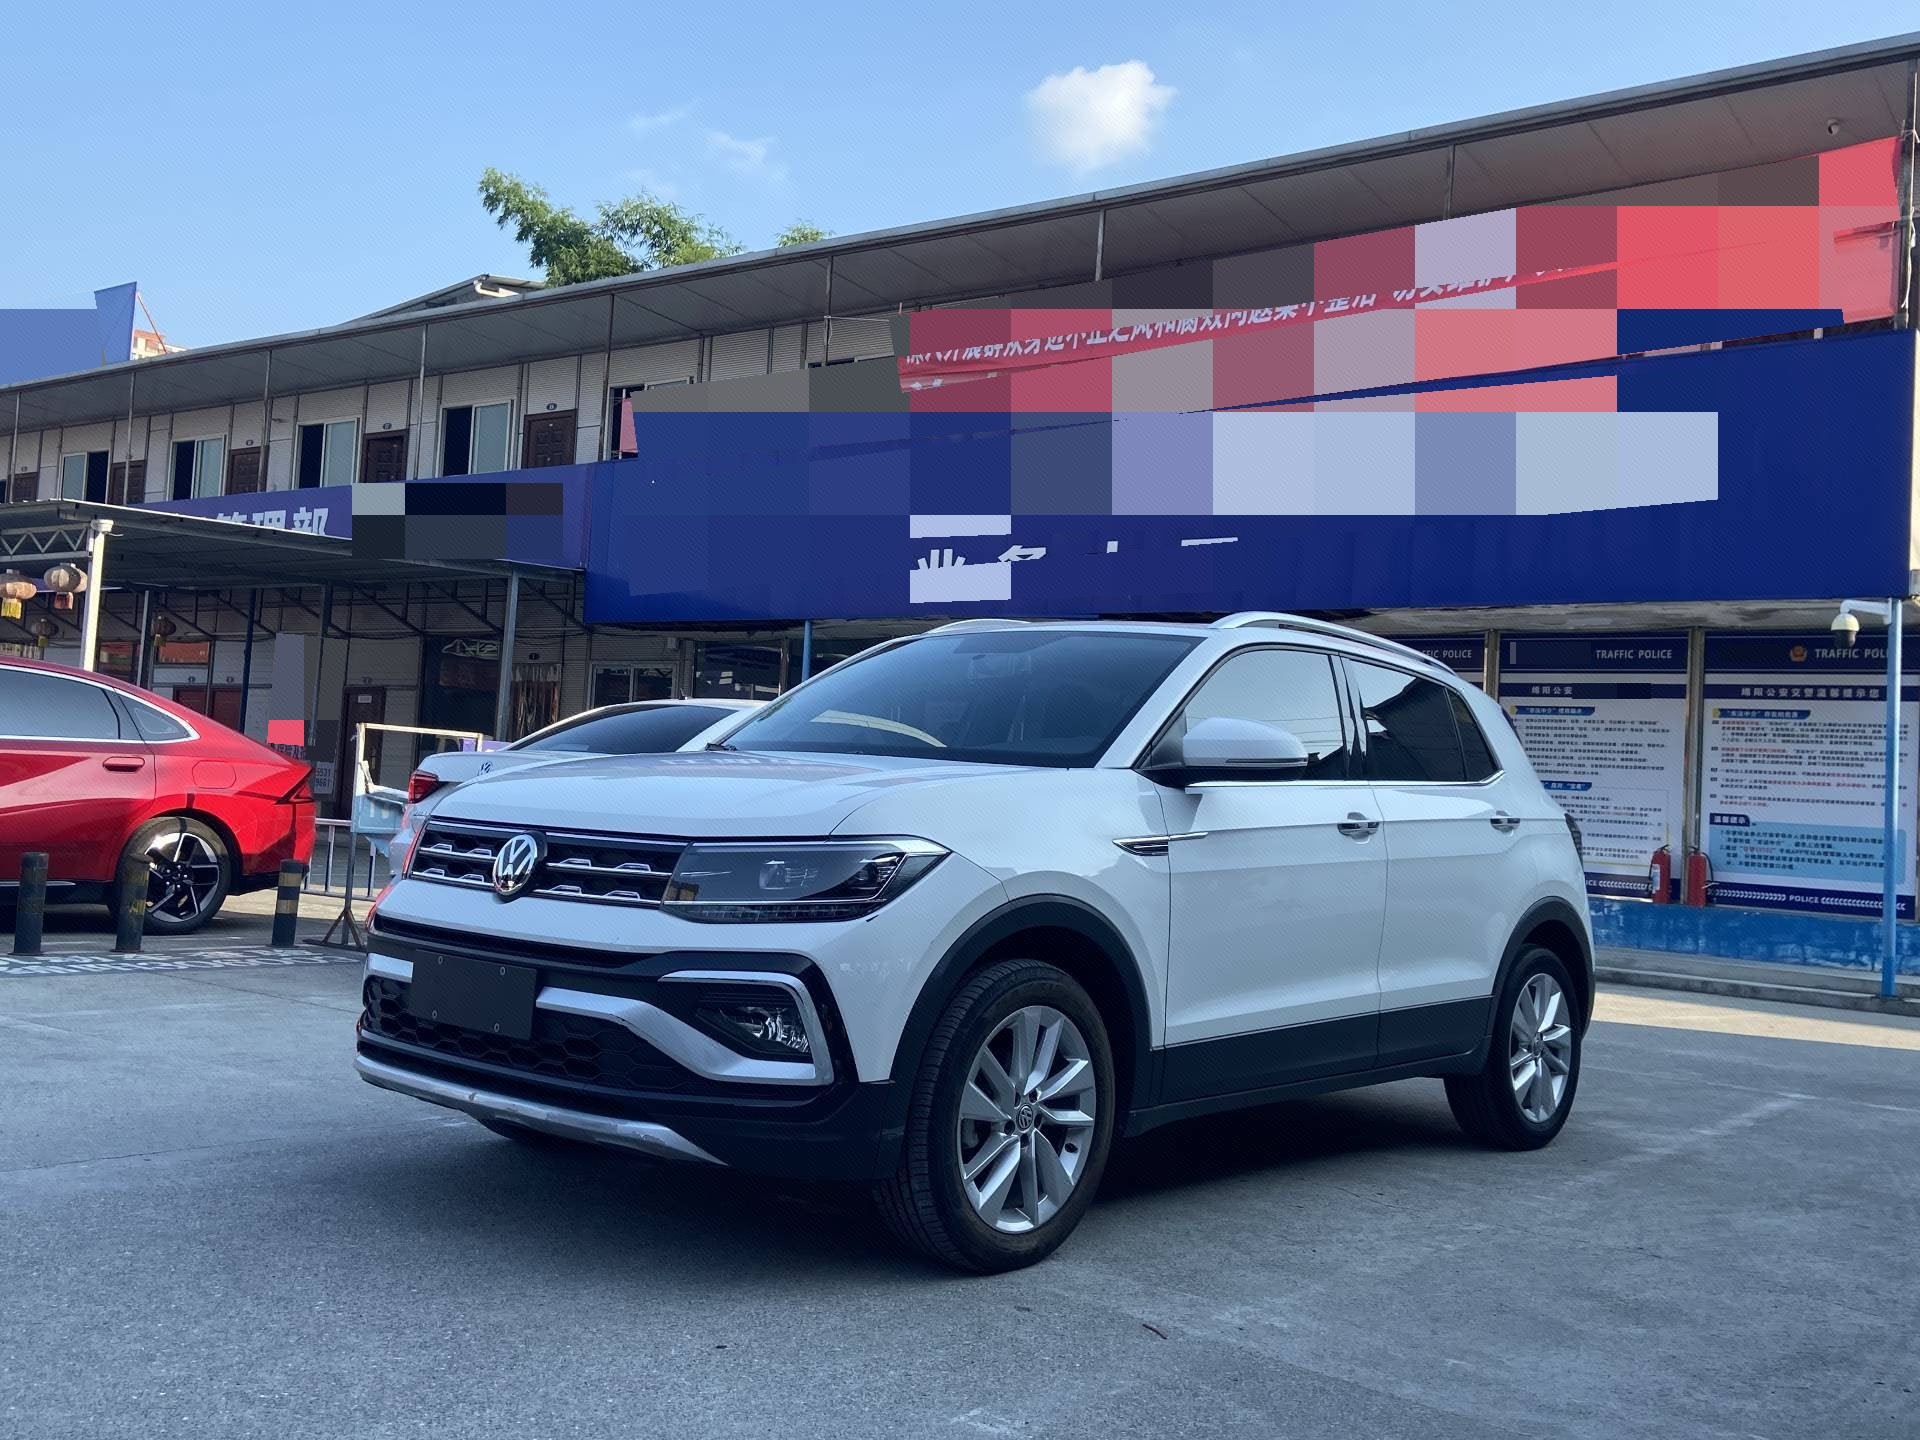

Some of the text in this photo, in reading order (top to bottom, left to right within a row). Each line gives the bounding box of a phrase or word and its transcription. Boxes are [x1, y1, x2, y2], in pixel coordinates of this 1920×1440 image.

[1443, 649, 1472, 658] POLICE
[1596, 650, 1672, 659] TRAFFIC POLICE
[1815, 649, 1859, 658] TRAFFIC
[1789, 895, 1819, 904] POLICE
